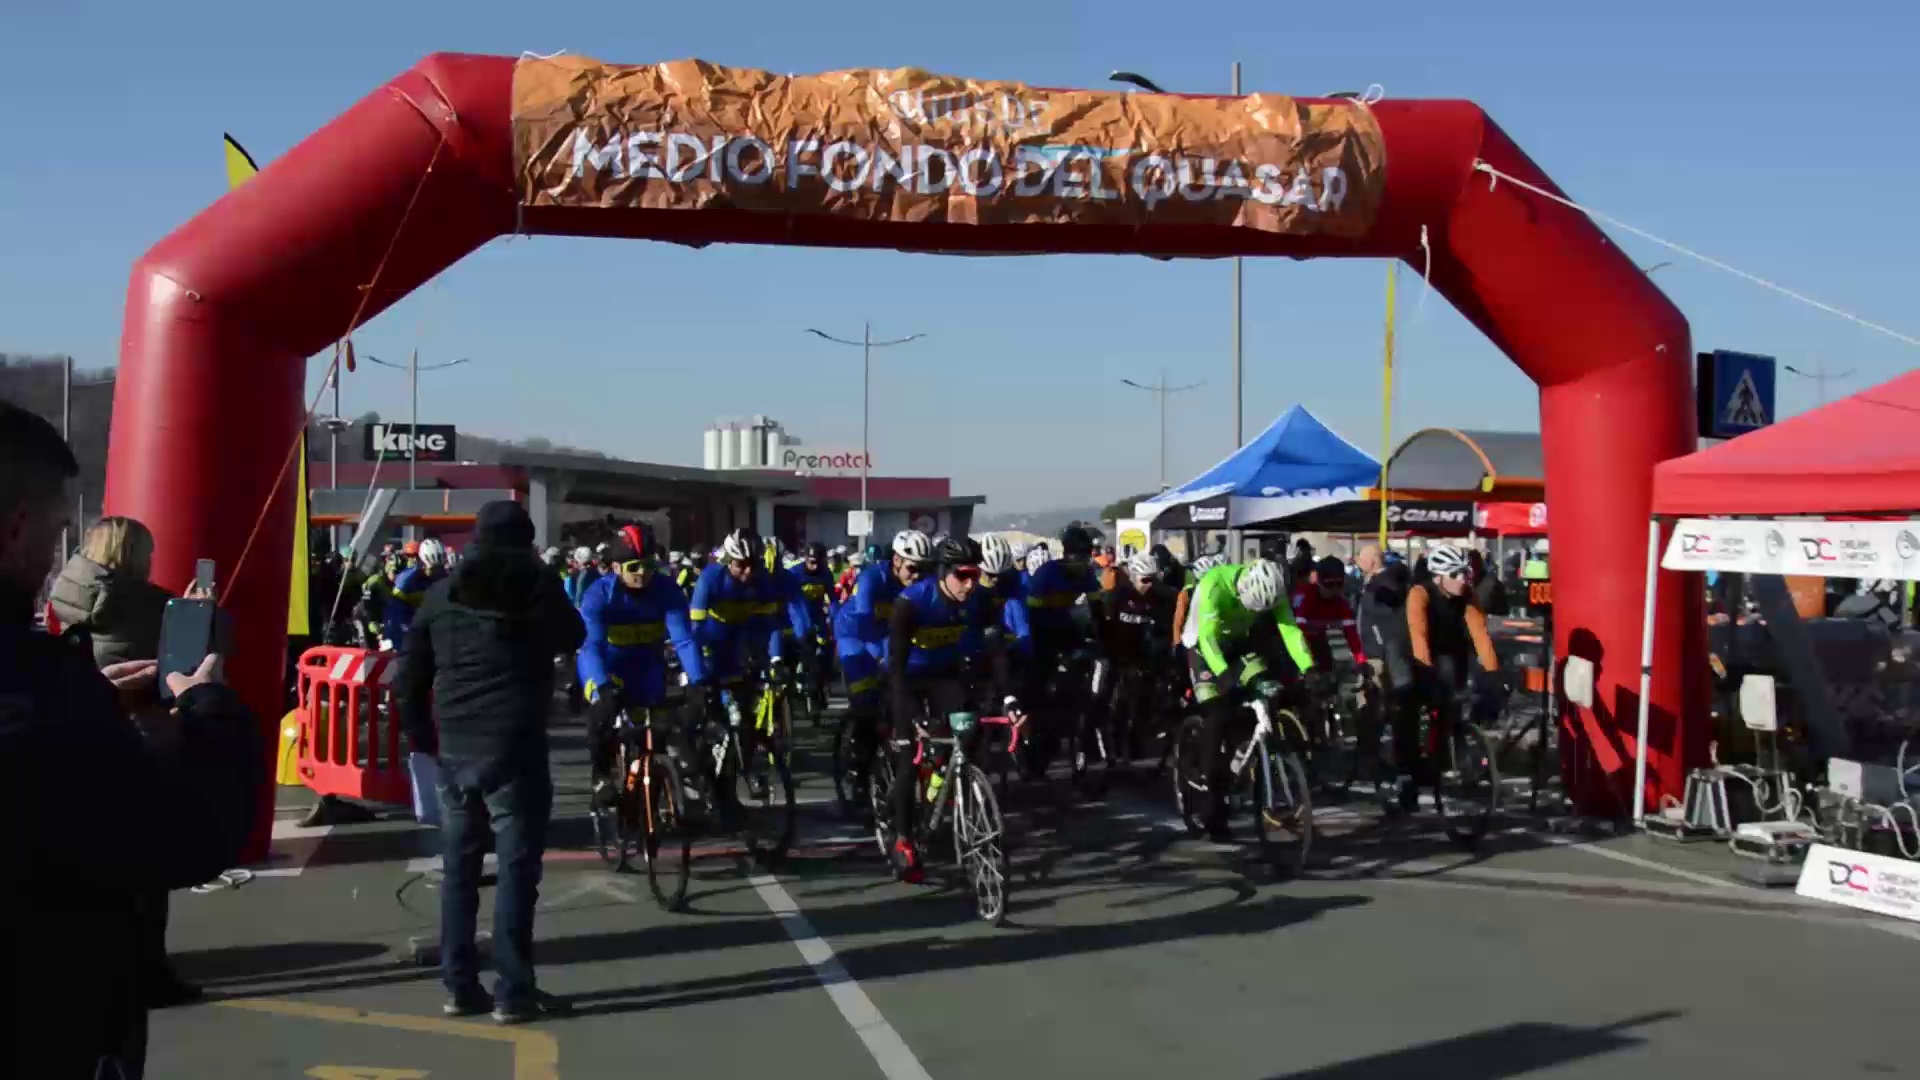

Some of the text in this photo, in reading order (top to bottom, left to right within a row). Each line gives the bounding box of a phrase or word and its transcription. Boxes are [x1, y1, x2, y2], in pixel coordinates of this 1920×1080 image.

[572, 126, 773, 185] MEDIO
[787, 136, 1001, 197] FONDO
[1015, 144, 1121, 199] DEL
[373, 425, 447, 451] KING
[783, 449, 873, 469] Prenatal
[1402, 508, 1469, 523] GIANT
